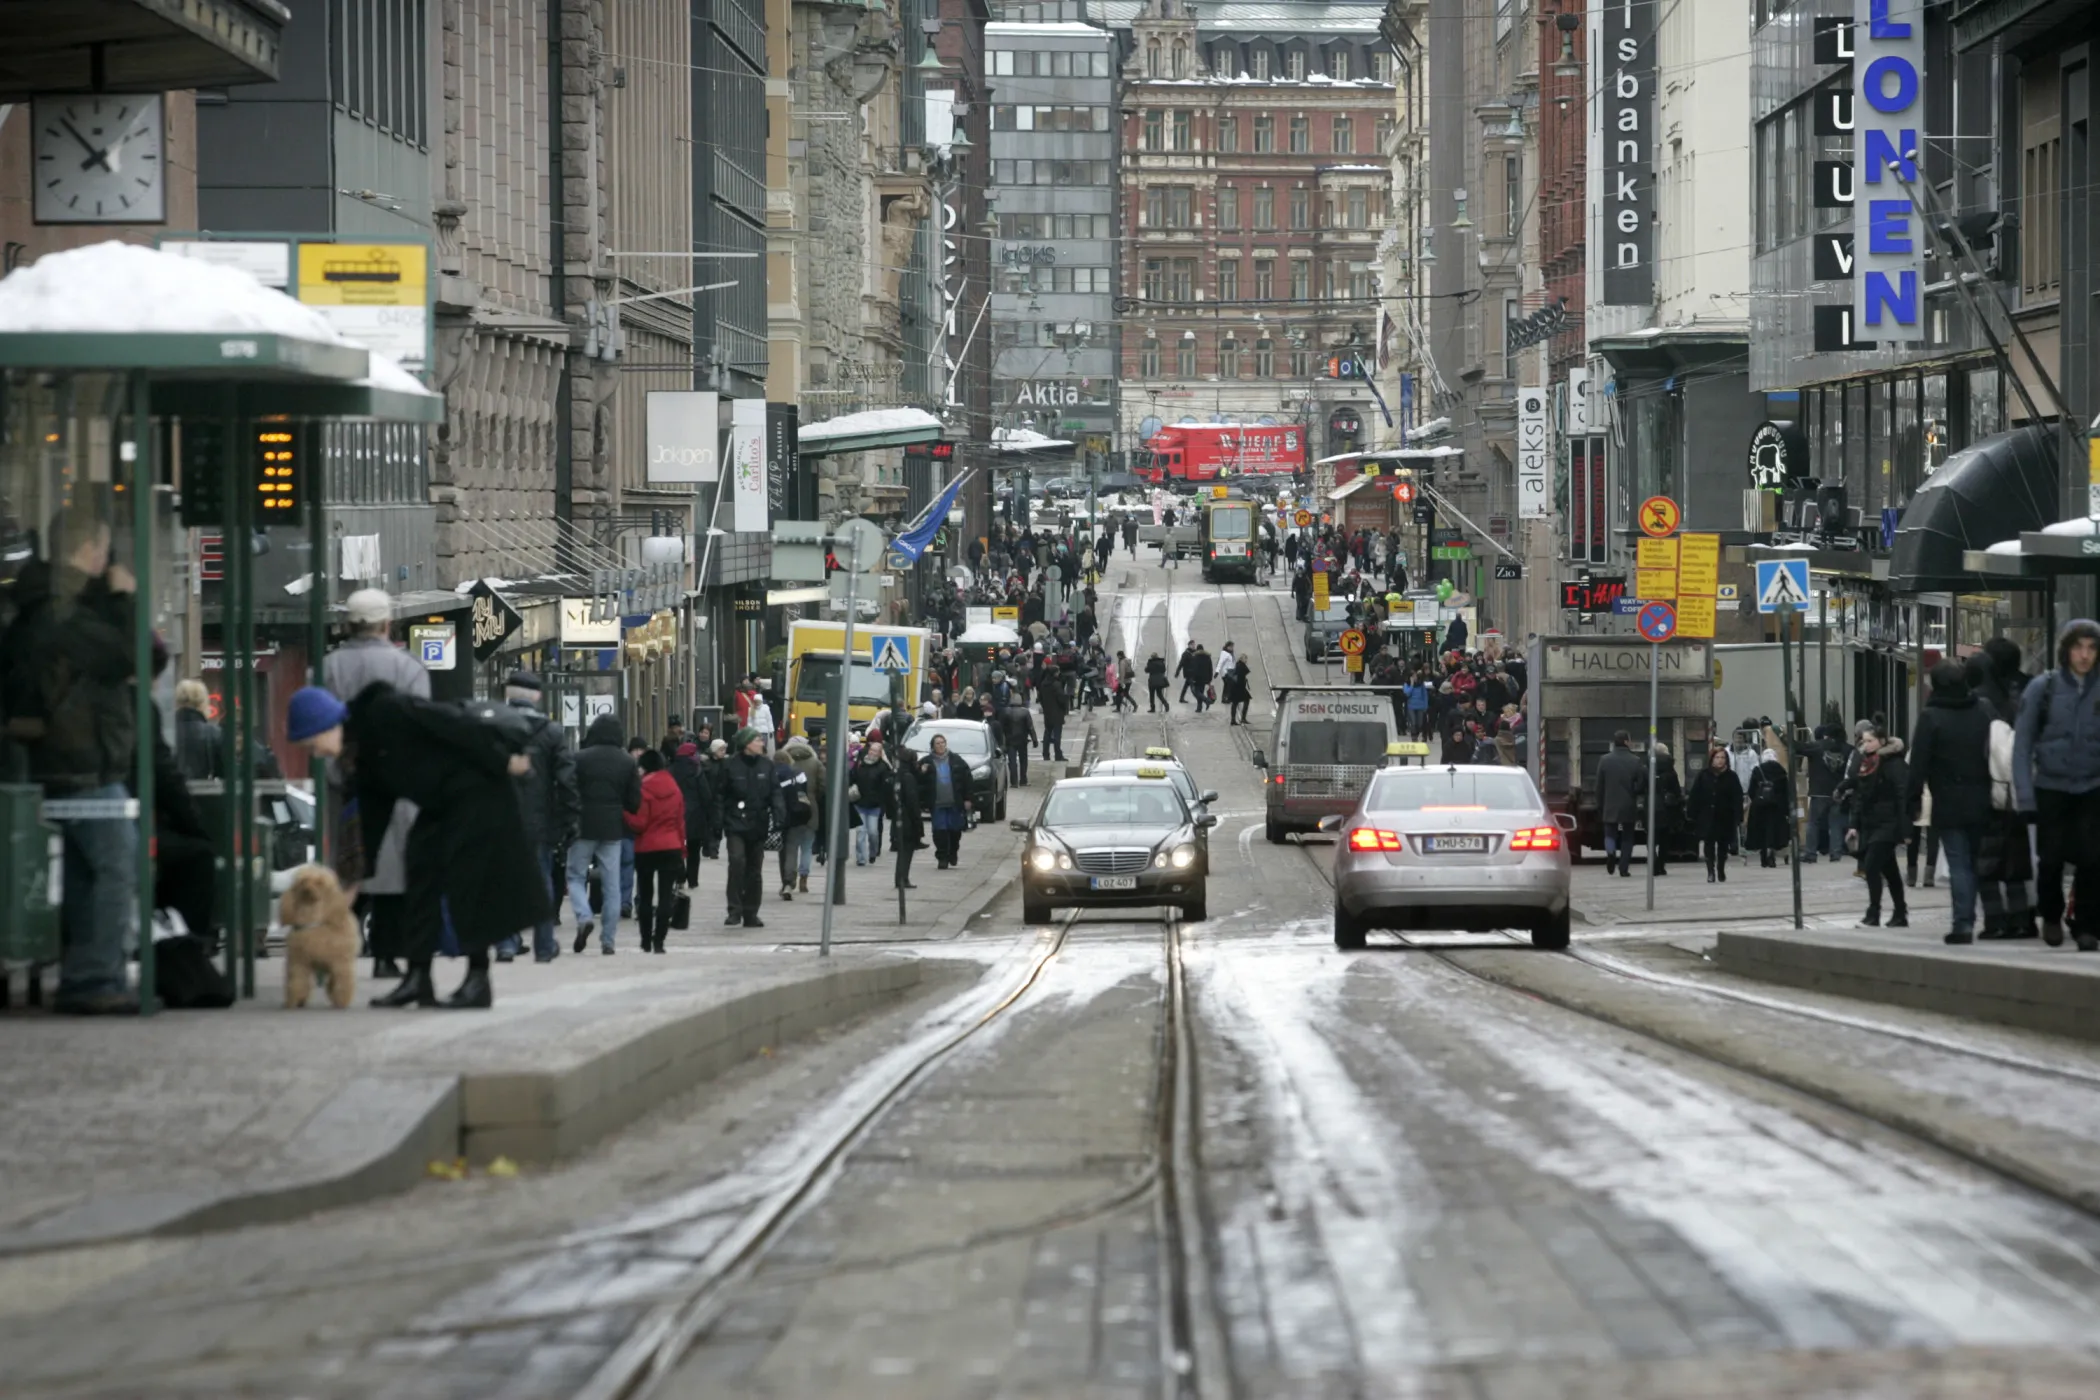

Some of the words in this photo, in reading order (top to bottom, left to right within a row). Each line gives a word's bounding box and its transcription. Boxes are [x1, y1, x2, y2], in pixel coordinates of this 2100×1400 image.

[1017, 380, 1079, 405] Aktia
[1298, 704, 1326, 714] SIGN
[1327, 704, 1379, 715] CONSULT
